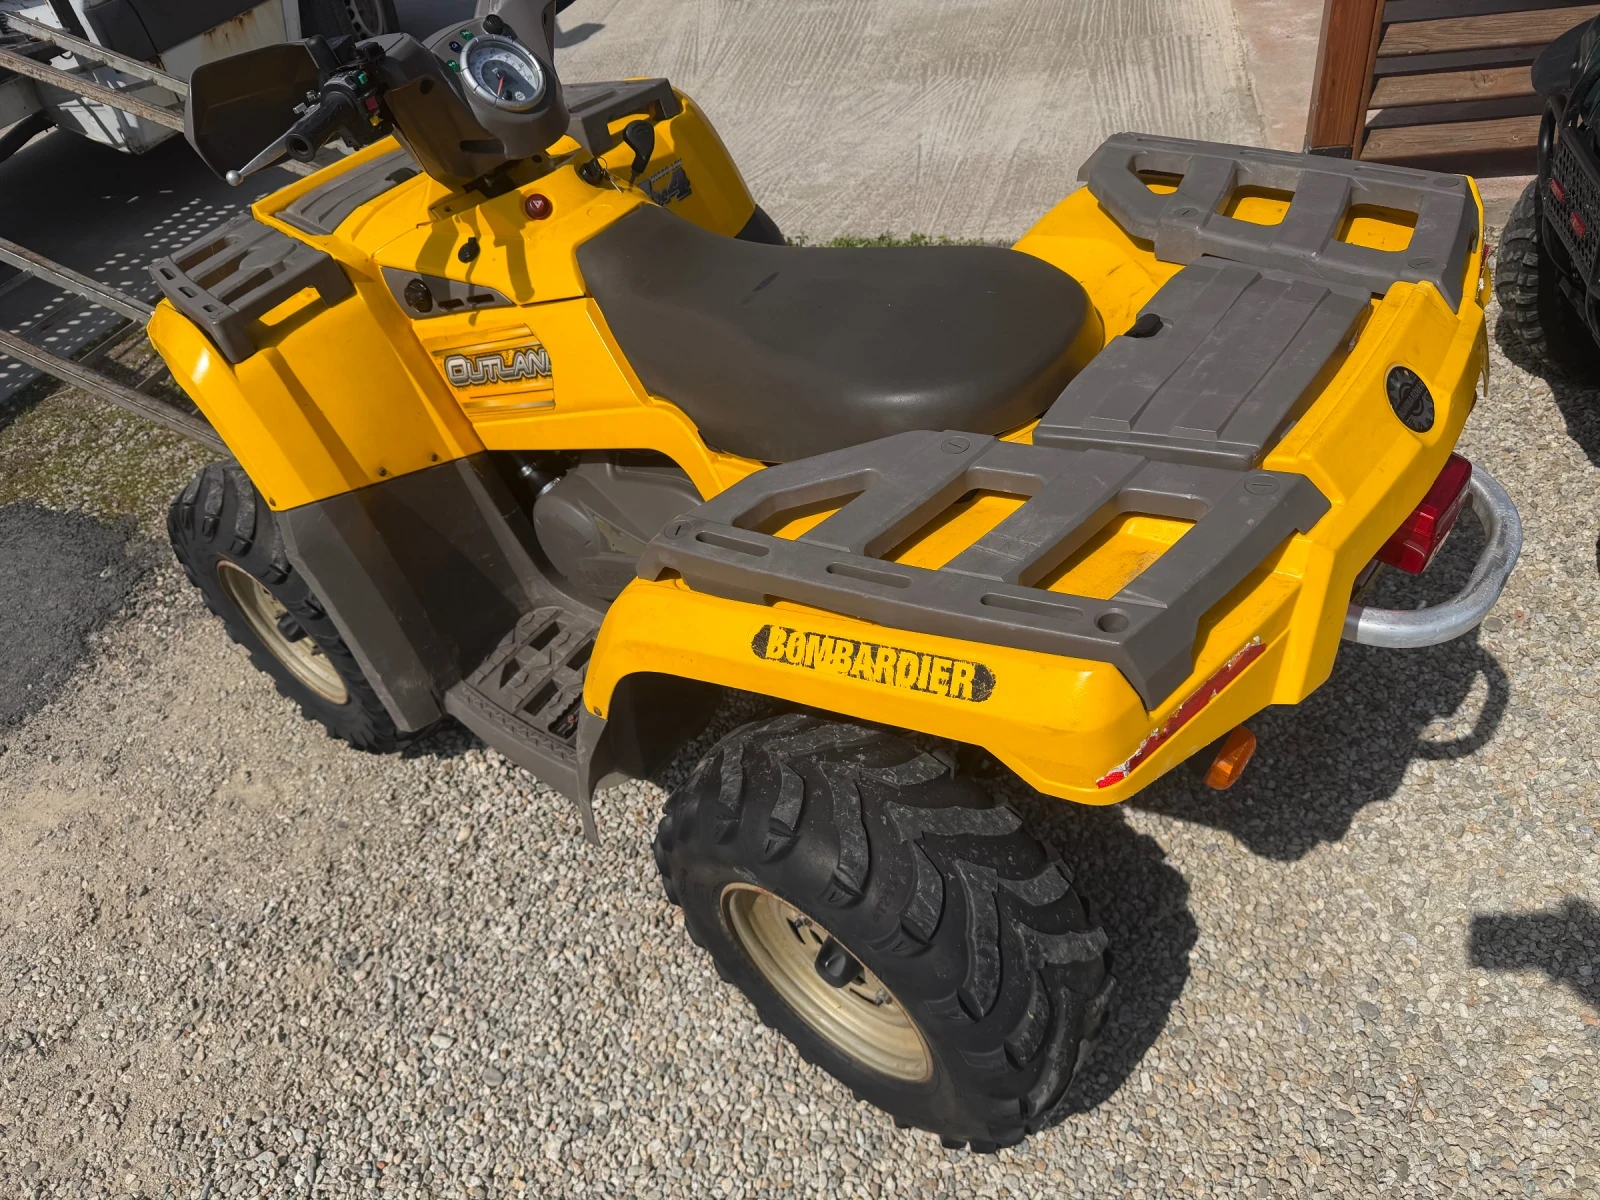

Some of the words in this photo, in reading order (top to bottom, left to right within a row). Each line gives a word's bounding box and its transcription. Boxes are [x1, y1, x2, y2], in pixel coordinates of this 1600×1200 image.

[445, 348, 552, 387] OUTLAN
[1397, 381, 1425, 418] BOMBARDIER
[766, 625, 977, 699] BOMBARDIER
